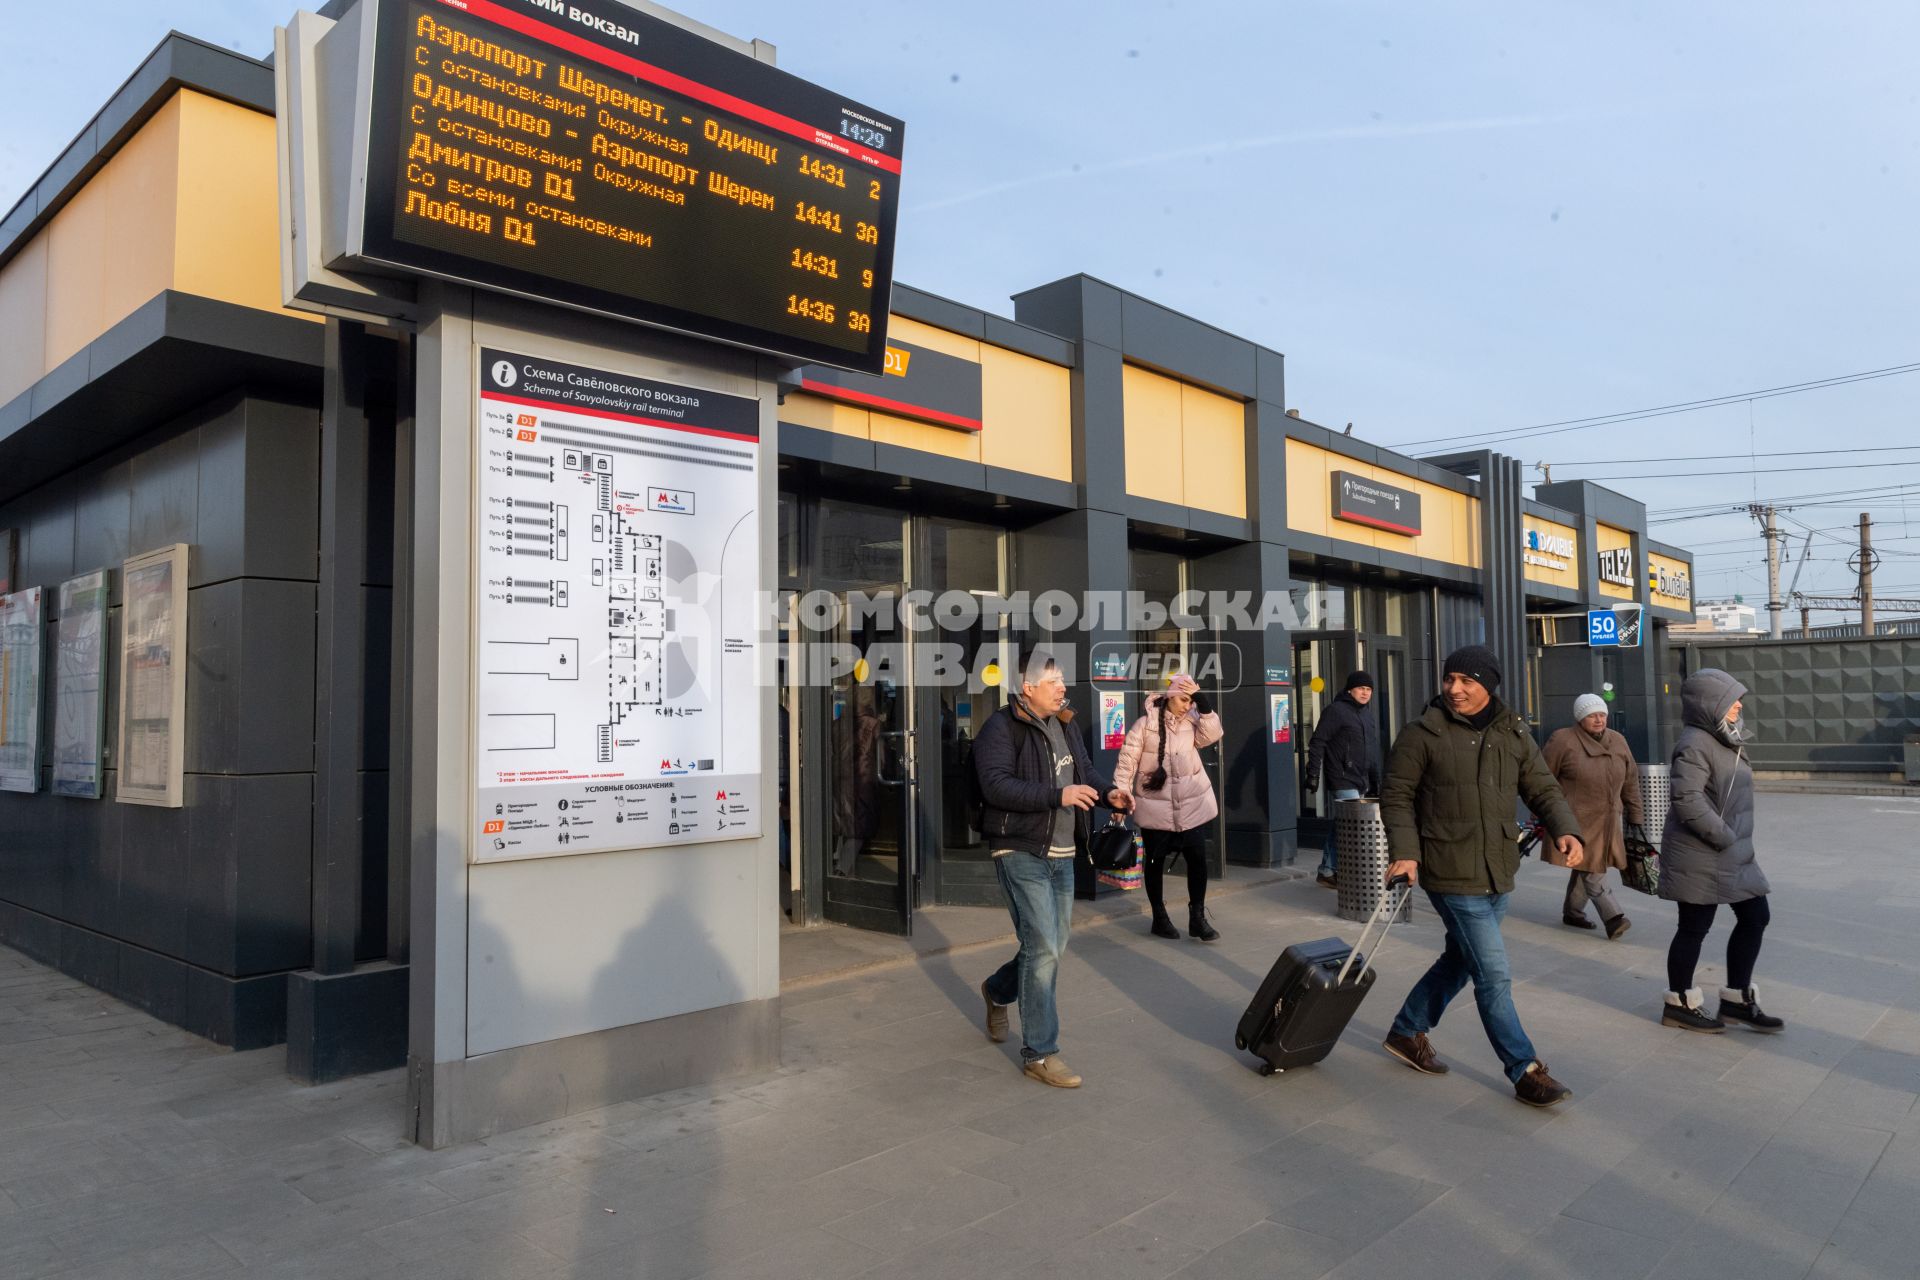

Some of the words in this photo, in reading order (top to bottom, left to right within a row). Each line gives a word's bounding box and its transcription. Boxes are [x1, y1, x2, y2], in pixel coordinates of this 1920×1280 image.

[569, 6, 639, 45] вокзал
[415, 46, 430, 66] С
[442, 60, 587, 118] остановками:
[598, 109, 689, 156] Окружная
[417, 15, 547, 79] Аэропорт
[559, 64, 669, 124] Шеремет.
[799, 154, 846, 188] 14:31
[869, 180, 881, 200] 2
[412, 72, 551, 138] Одинцово
[592, 133, 698, 186] Аэропорт
[708, 171, 775, 211] Шерем
[795, 201, 842, 234] 14:41
[840, 119, 885, 148] 14:29
[411, 105, 425, 124] С
[437, 118, 582, 172] остановками:
[594, 163, 684, 205] Окружная
[407, 163, 436, 187] Со
[448, 179, 515, 210] всеми
[526, 202, 652, 248] остановками
[409, 132, 532, 188] Дмитров
[544, 172, 575, 201] D1
[791, 248, 838, 278] 14:31
[862, 269, 873, 288] 9
[405, 190, 491, 234] Лобня
[504, 216, 536, 246] D1
[787, 294, 835, 323] 14:36
[523, 365, 564, 383] Схема
[567, 373, 652, 399] Савёловского
[655, 391, 700, 407] вокзала
[523, 383, 561, 397] Scheme
[563, 390, 574, 399] of
[575, 391, 631, 410] Savyolovskiy
[632, 403, 647, 412] rail
[649, 406, 684, 418] terminal
[521, 416, 533, 424] D1
[521, 432, 533, 440] D1
[1599, 548, 1635, 587] TELE2
[1592, 617, 1615, 633] 50
[585, 785, 623, 793] УСЛОВНЫЕ
[625, 782, 675, 791] ОБОЗНАЧЕНИЯ:
[488, 823, 500, 831] D1
